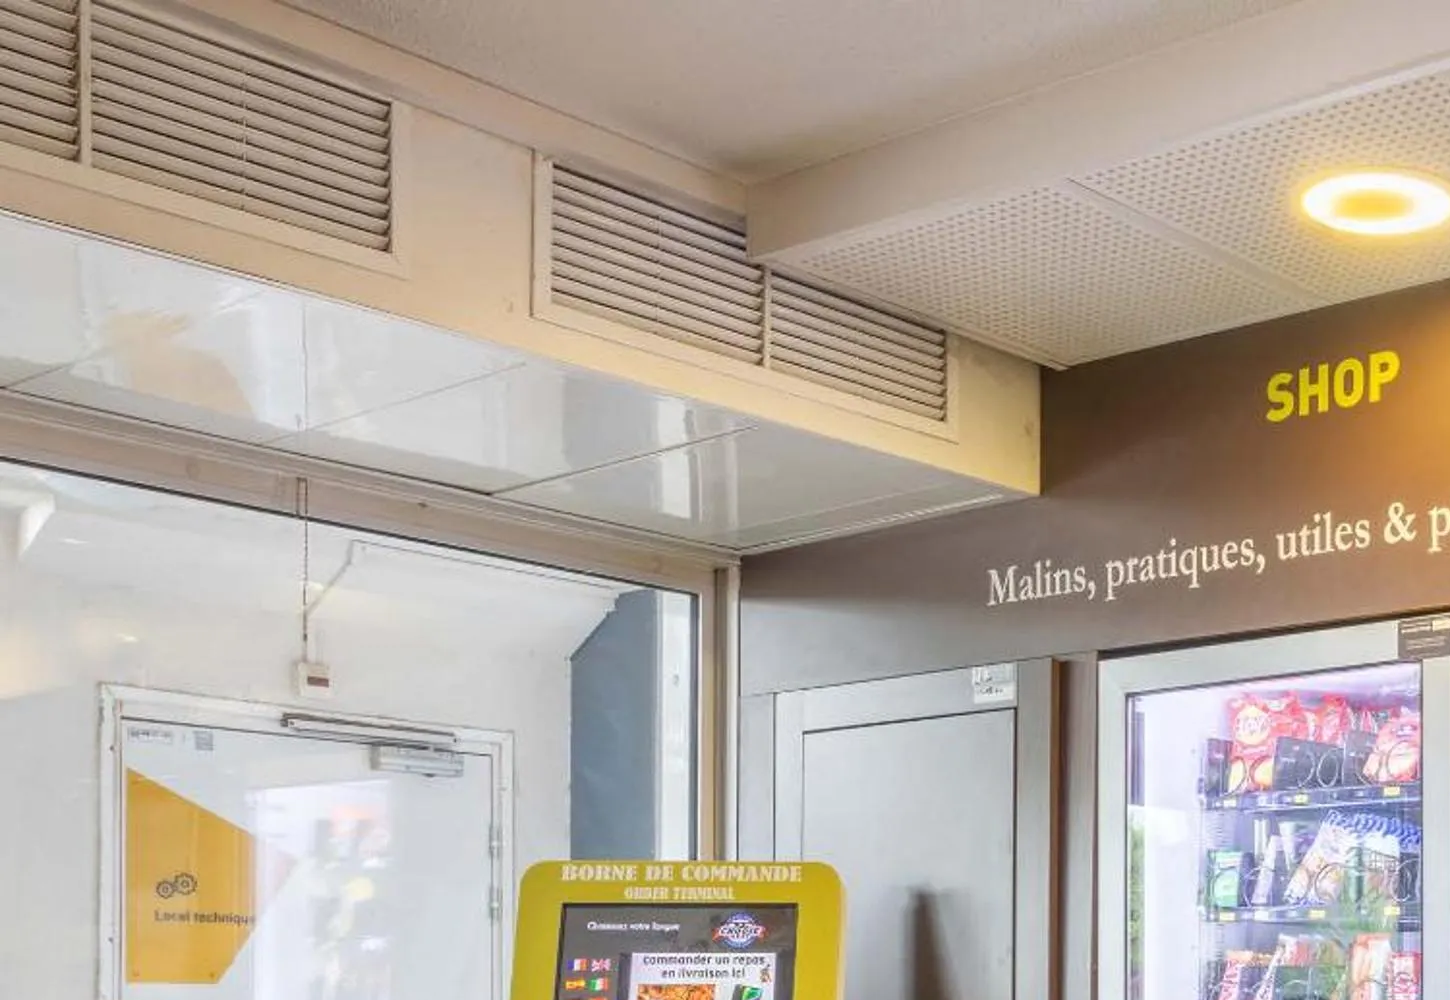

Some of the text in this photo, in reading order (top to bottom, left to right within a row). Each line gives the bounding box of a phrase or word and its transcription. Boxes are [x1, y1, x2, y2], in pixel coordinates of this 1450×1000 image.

[1266, 350, 1400, 422] SHOP
[986, 559, 1096, 606] Malins,
[1105, 537, 1266, 601] pratiques,
[1275, 511, 1371, 561] utiles
[1383, 501, 1417, 544] &
[561, 864, 802, 883] BORNE DE COMMANDE
[624, 887, 735, 900] ORDER TERMINAL
[154, 909, 190, 922] Local
